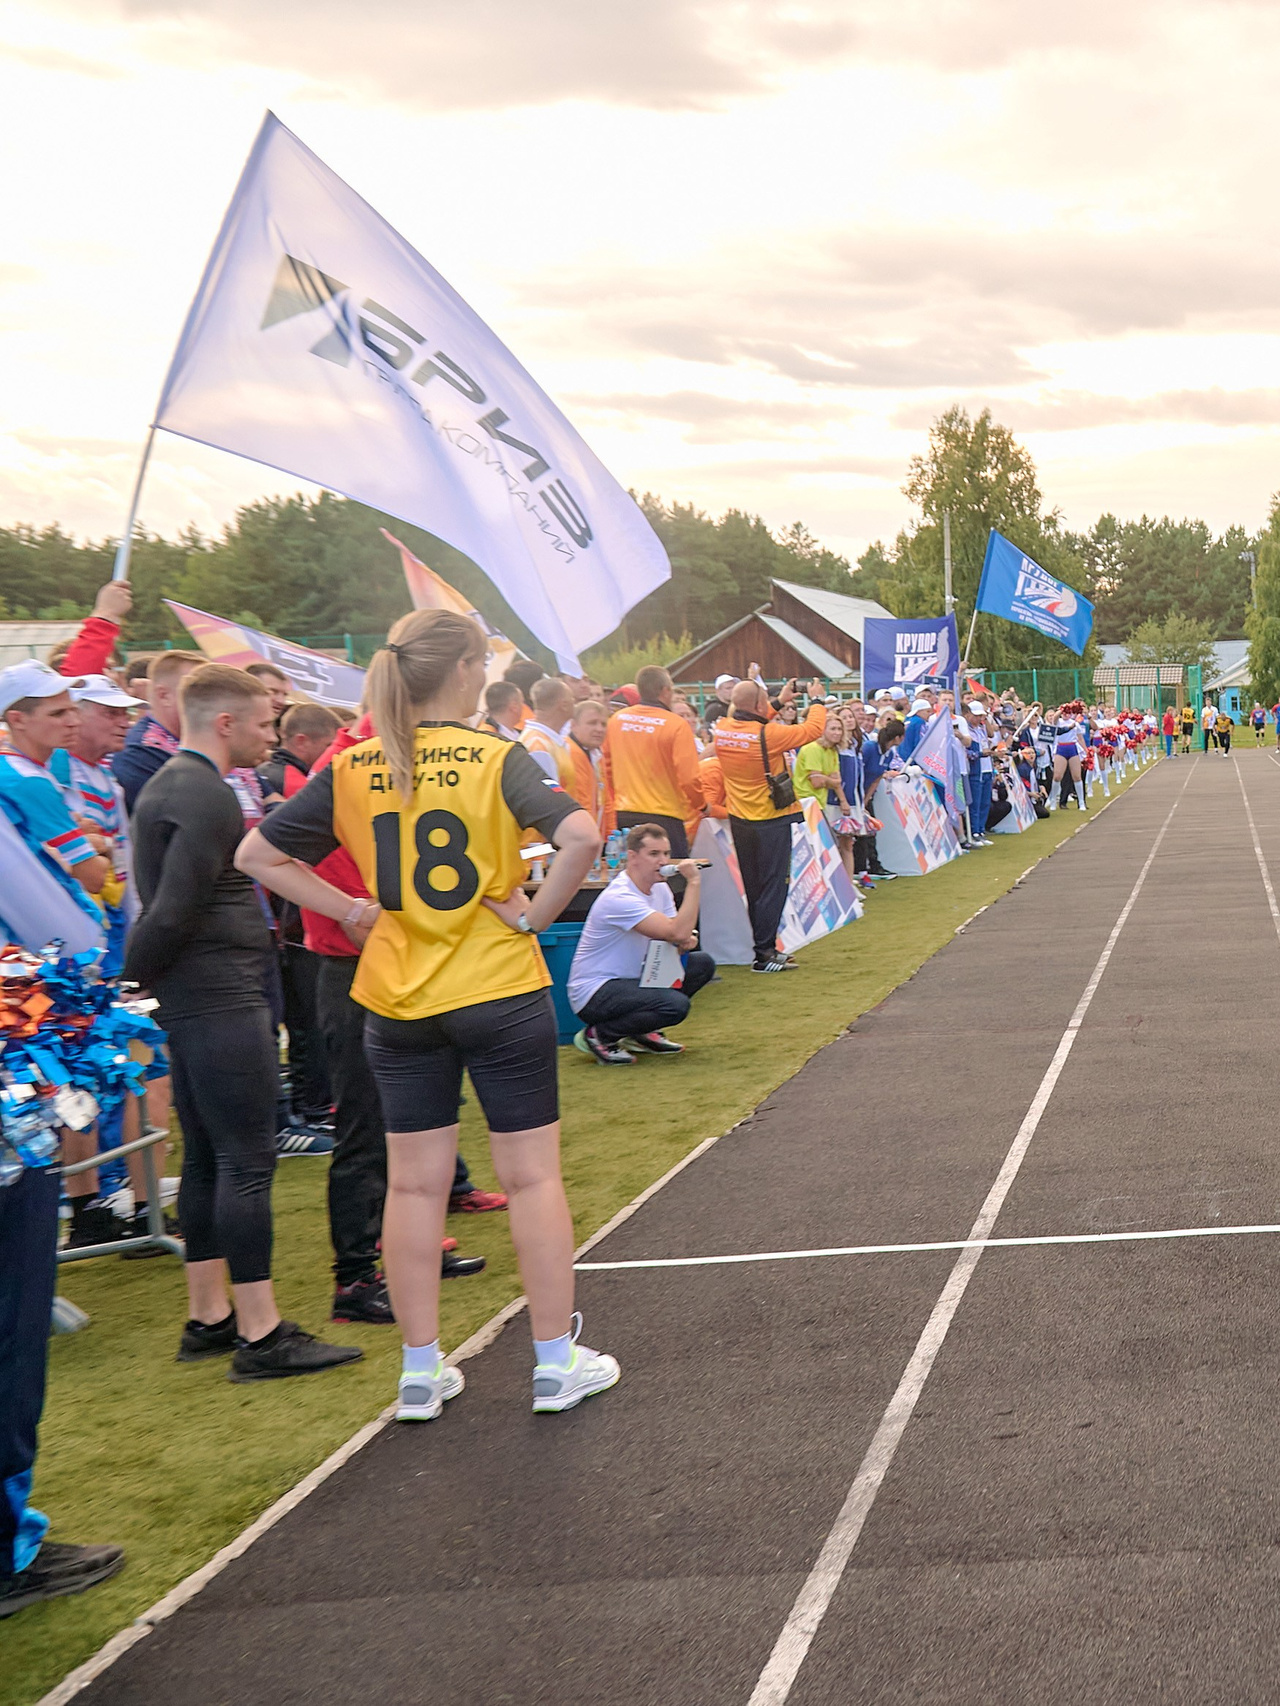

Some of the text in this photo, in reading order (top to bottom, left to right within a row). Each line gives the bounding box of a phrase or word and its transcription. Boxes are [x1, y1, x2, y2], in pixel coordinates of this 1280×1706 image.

[357, 297, 593, 549] БРИЗ
[437, 420, 575, 564] КОМПАНИЙ
[896, 632, 937, 653] КРУДОР
[351, 746, 485, 769] МИИНСК
[370, 770, 459, 793] ДУ-10
[372, 809, 479, 911] 18
